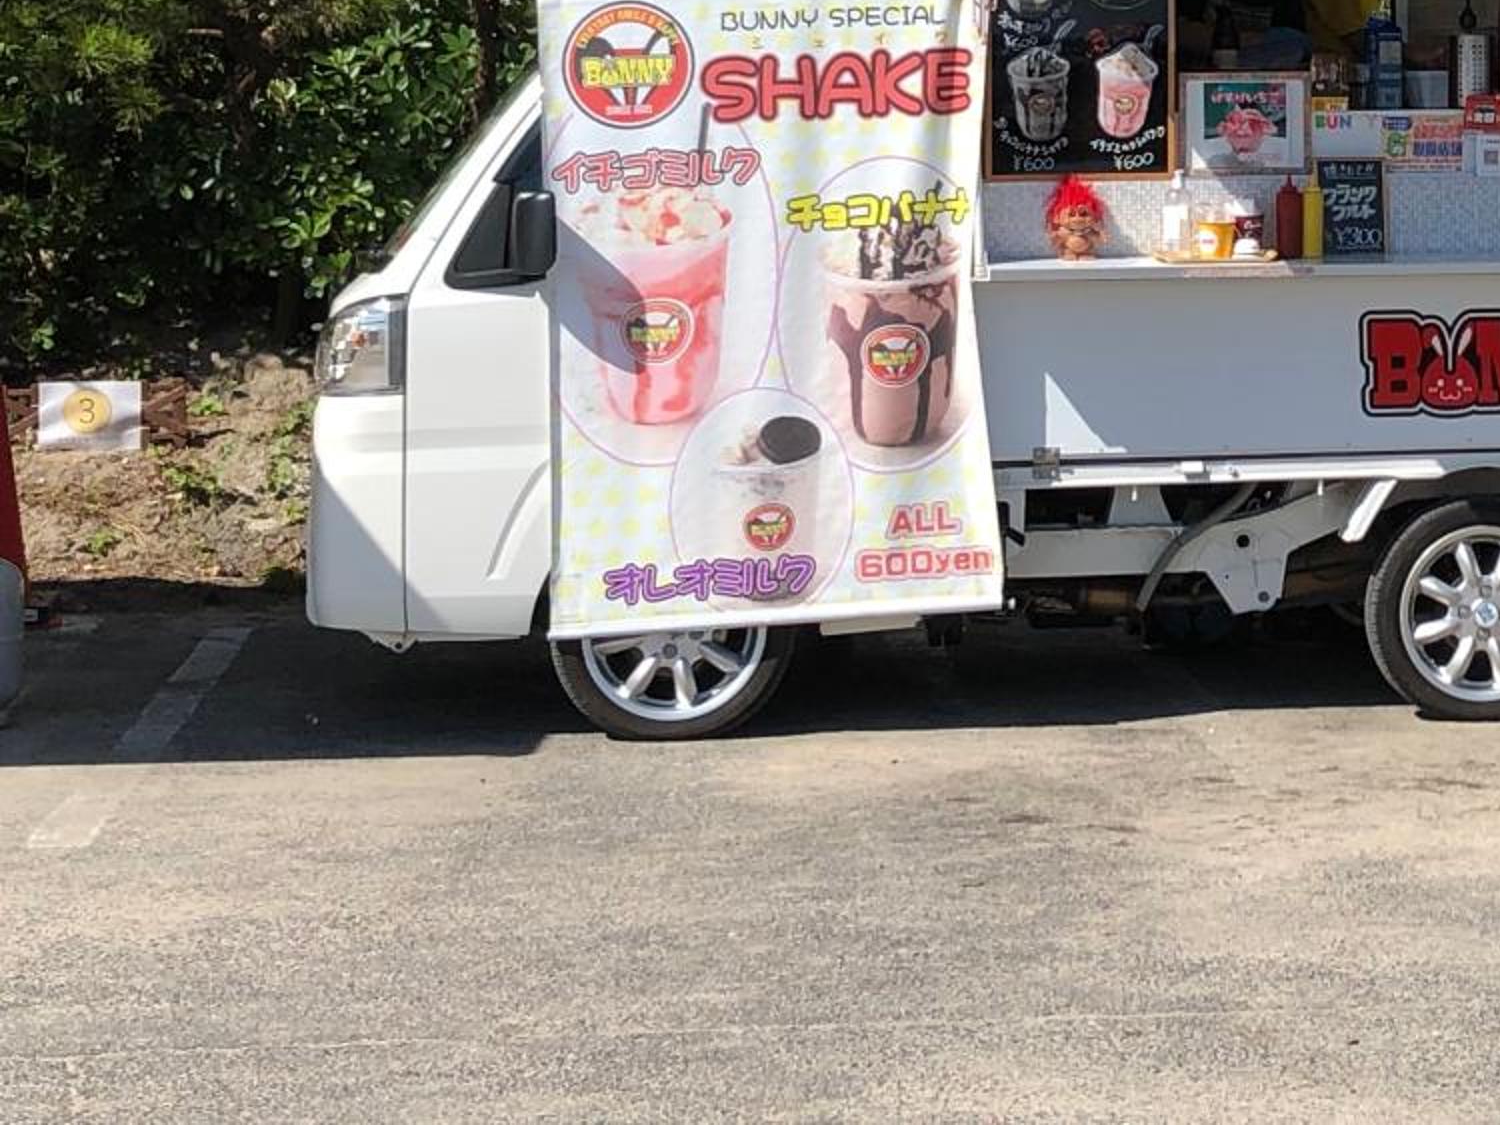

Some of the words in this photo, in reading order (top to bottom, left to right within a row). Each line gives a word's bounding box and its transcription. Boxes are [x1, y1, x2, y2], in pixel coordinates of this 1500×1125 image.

[720, 8, 819, 32] BUNNY
[828, 4, 946, 27] SPECIAL
[700, 48, 974, 123] SHAKE
[551, 145, 762, 194] イチゴミルク
[1113, 151, 1155, 171] ¥600
[786, 186, 971, 232] チョコバナナ
[78, 398, 96, 425] 3
[887, 501, 962, 538] ALL
[603, 552, 817, 605] オレオミルク
[857, 546, 994, 582] 600yen
